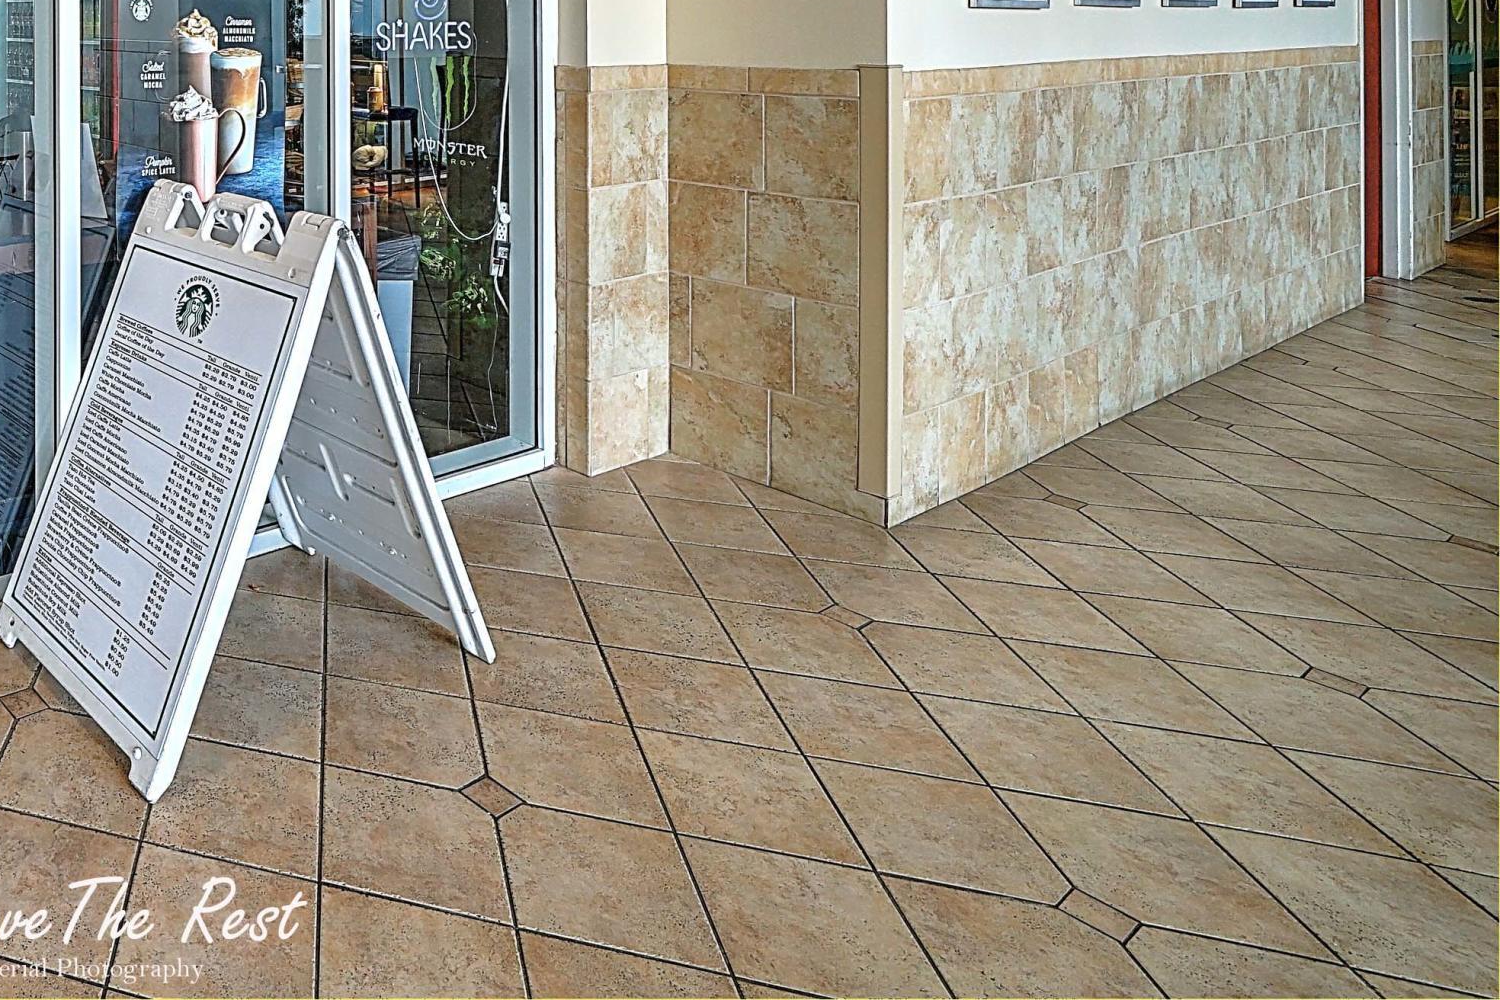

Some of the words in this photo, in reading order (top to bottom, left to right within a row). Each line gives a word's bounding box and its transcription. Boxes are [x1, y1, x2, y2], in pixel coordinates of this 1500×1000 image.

[376, 21, 471, 51] SHAKES
[413, 137, 487, 159] MONSTER
[141, 168, 158, 176] SPICE
[423, 155, 476, 167] ENRGY
[177, 284, 185, 296] WE
[186, 275, 212, 285] PROUDLY
[211, 283, 221, 308] SERVE
